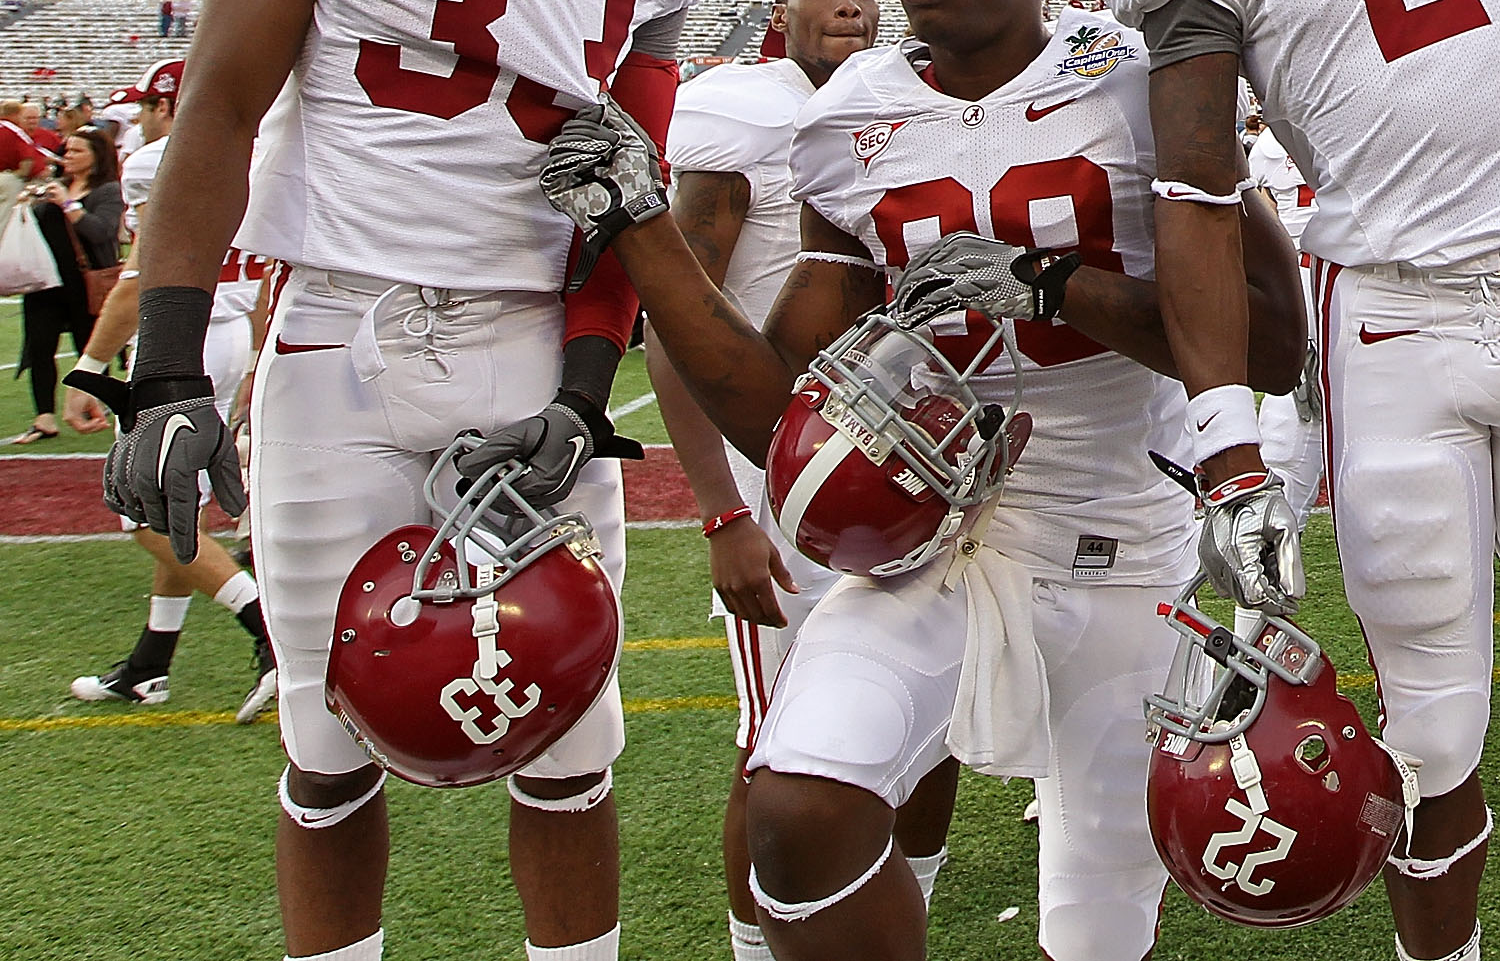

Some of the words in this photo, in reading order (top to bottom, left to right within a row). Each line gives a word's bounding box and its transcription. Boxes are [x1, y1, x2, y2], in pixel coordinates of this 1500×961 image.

[858, 131, 885, 152] SEC
[839, 413, 878, 448] BAMA
[892, 468, 930, 496] NIKE
[1086, 541, 1105, 553] 44
[440, 649, 542, 745] 33
[1160, 732, 1192, 756] NIKE
[1202, 797, 1298, 897] 22
